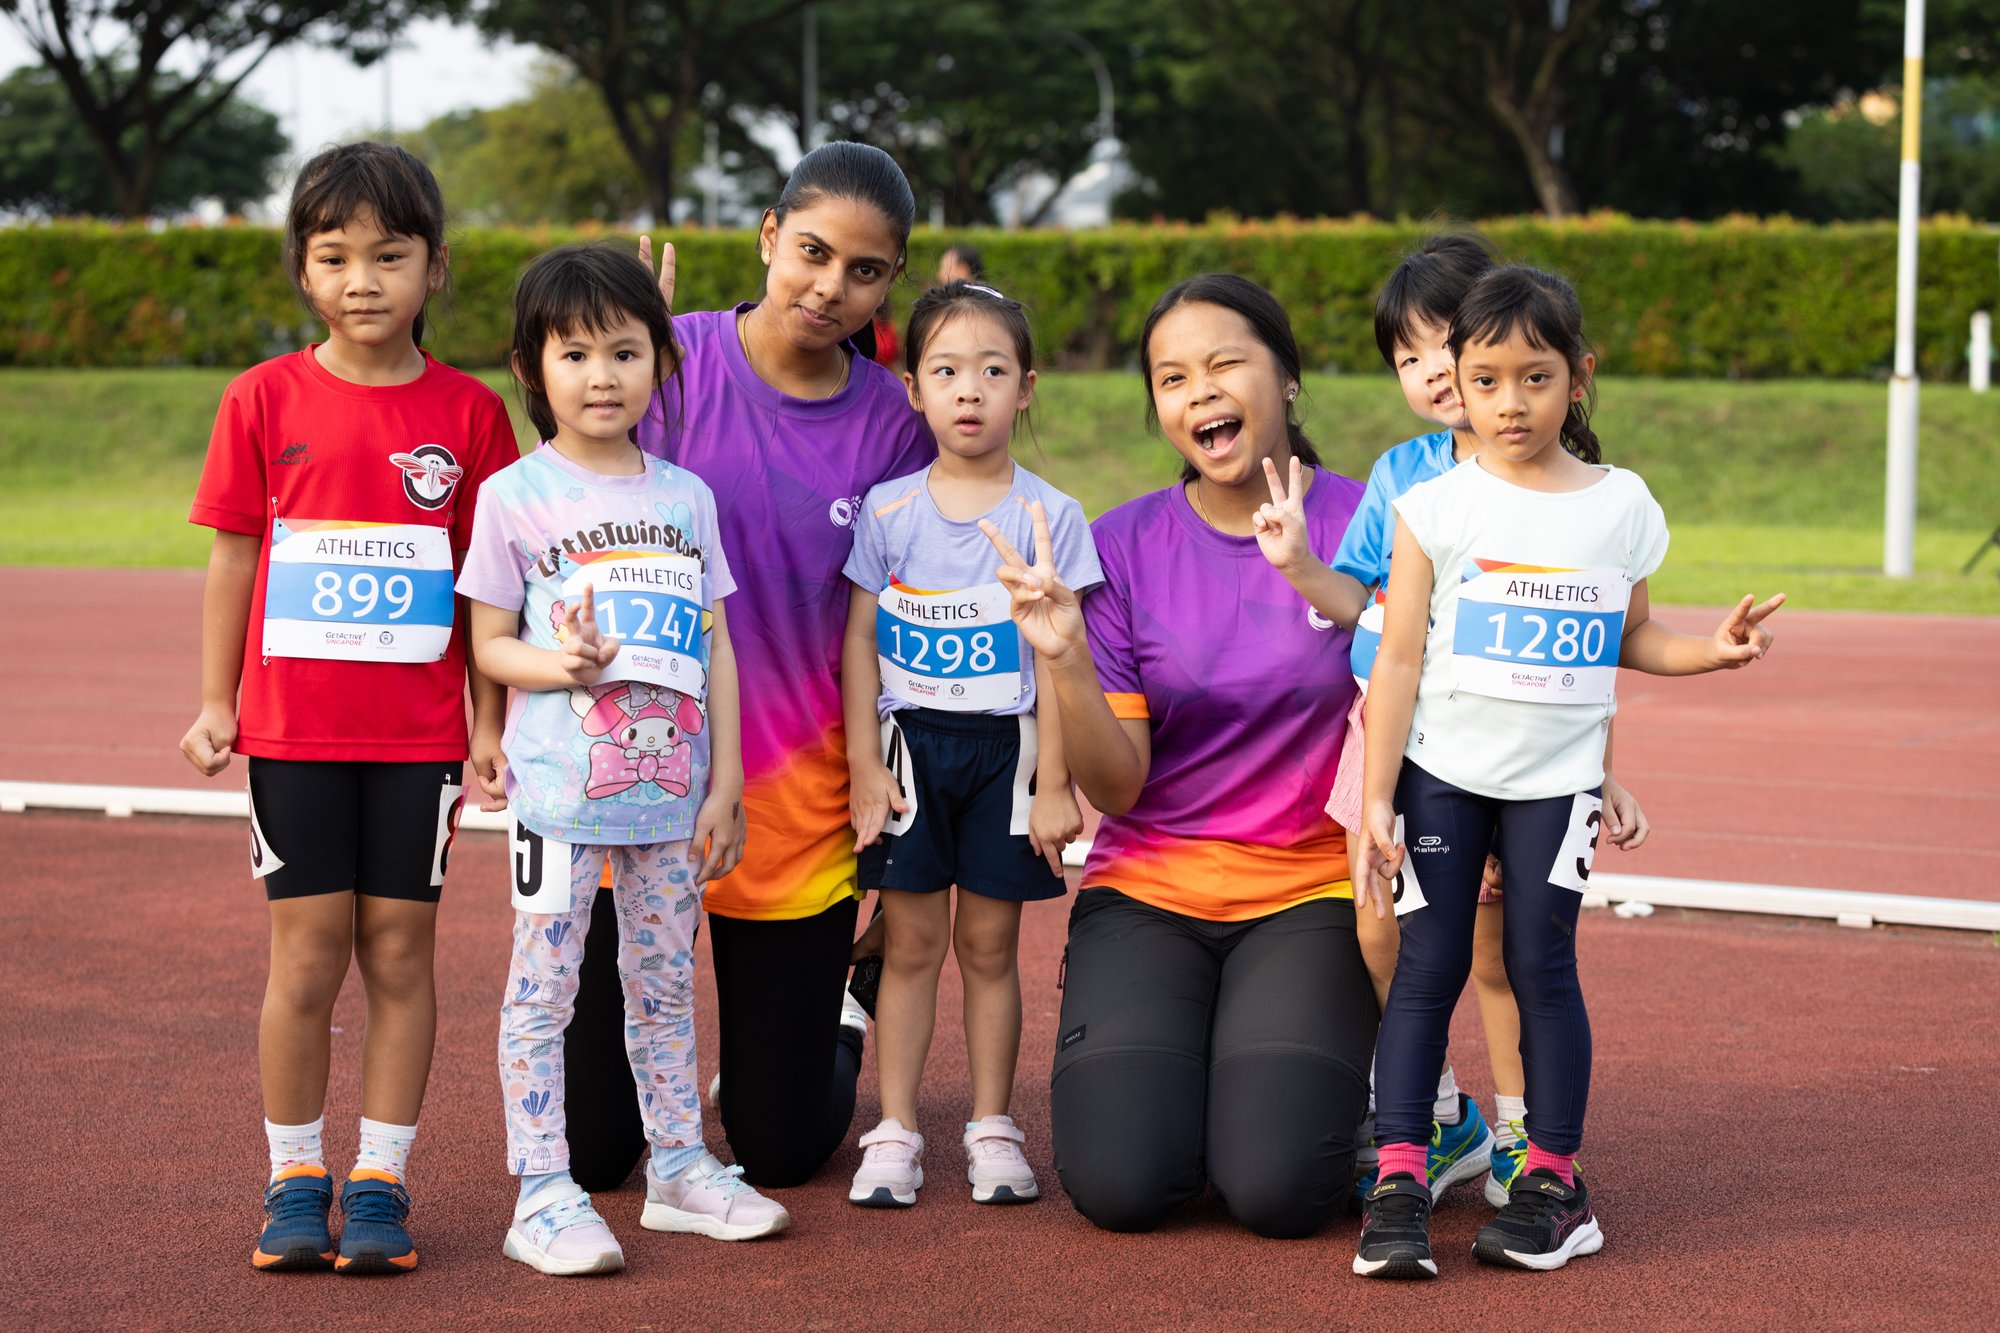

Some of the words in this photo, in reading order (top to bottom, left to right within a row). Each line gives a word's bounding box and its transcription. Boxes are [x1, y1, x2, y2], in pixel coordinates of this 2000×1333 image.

[315, 537, 416, 560] ATHLETICS
[609, 567, 693, 591] ATHLETICS
[311, 570, 415, 620] 899
[1506, 580, 1599, 603] ATHLETICS
[897, 597, 979, 620] ATHLETICS
[596, 597, 698, 651] 1247
[326, 638, 363, 646] SINGAPORE
[1484, 611, 1606, 663] 1280
[890, 624, 997, 674] 1298
[1511, 680, 1547, 688] SINGAPORE
[1413, 845, 1450, 854] Kalenji
